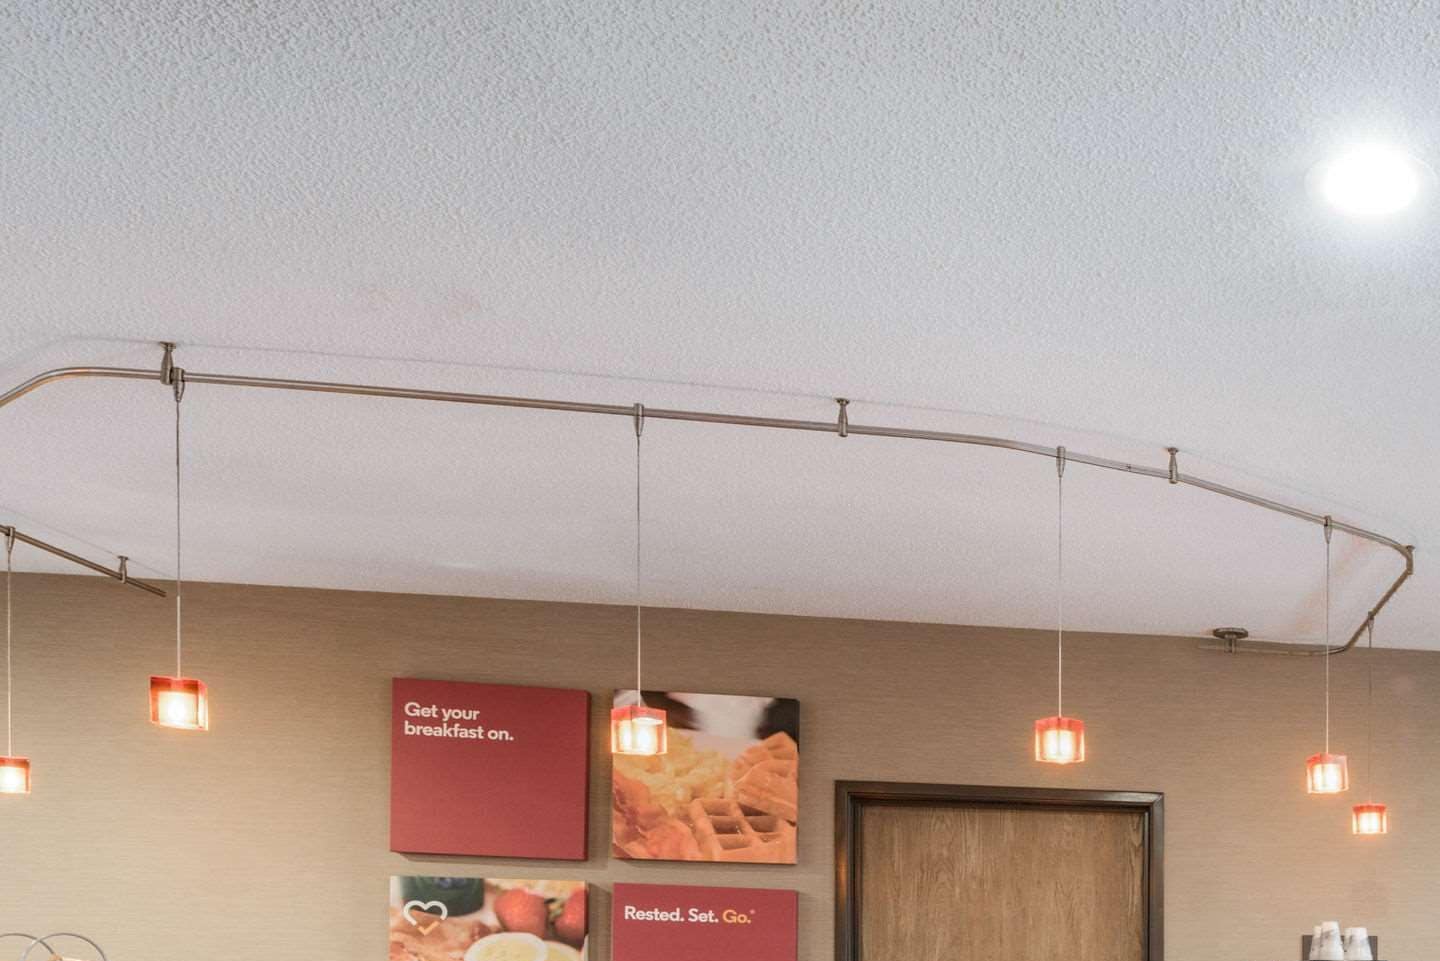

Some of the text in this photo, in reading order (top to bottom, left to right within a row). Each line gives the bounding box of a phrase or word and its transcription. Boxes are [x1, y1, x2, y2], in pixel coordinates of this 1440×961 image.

[404, 701, 480, 721] Get your
[404, 719, 514, 741] breakfast on.
[624, 905, 685, 922] Rested.
[687, 907, 719, 923] Set.
